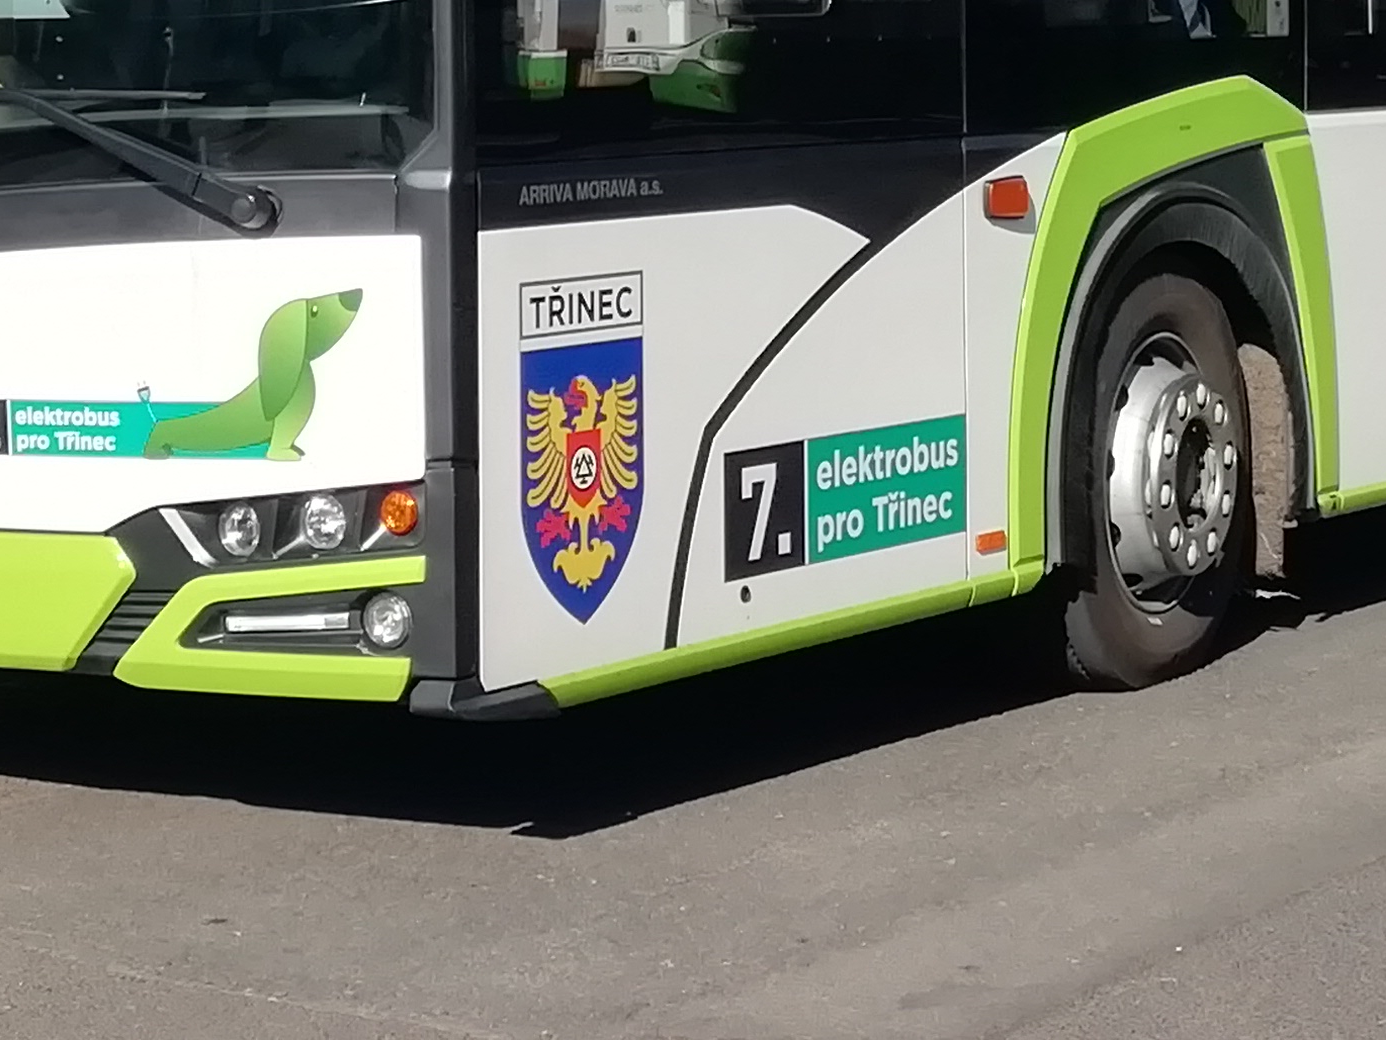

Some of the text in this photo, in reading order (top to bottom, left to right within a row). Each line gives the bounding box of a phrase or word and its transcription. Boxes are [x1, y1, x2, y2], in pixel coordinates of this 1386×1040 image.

[519, 177, 664, 206] ARRIVA MORAVA a.s.
[529, 285, 633, 329] TŘINEC
[14, 407, 121, 428] elektrobus
[16, 431, 118, 452] pro Třinec
[816, 436, 960, 491] elektrobus
[740, 462, 792, 562] 7.
[817, 491, 954, 553] pro Třinec
